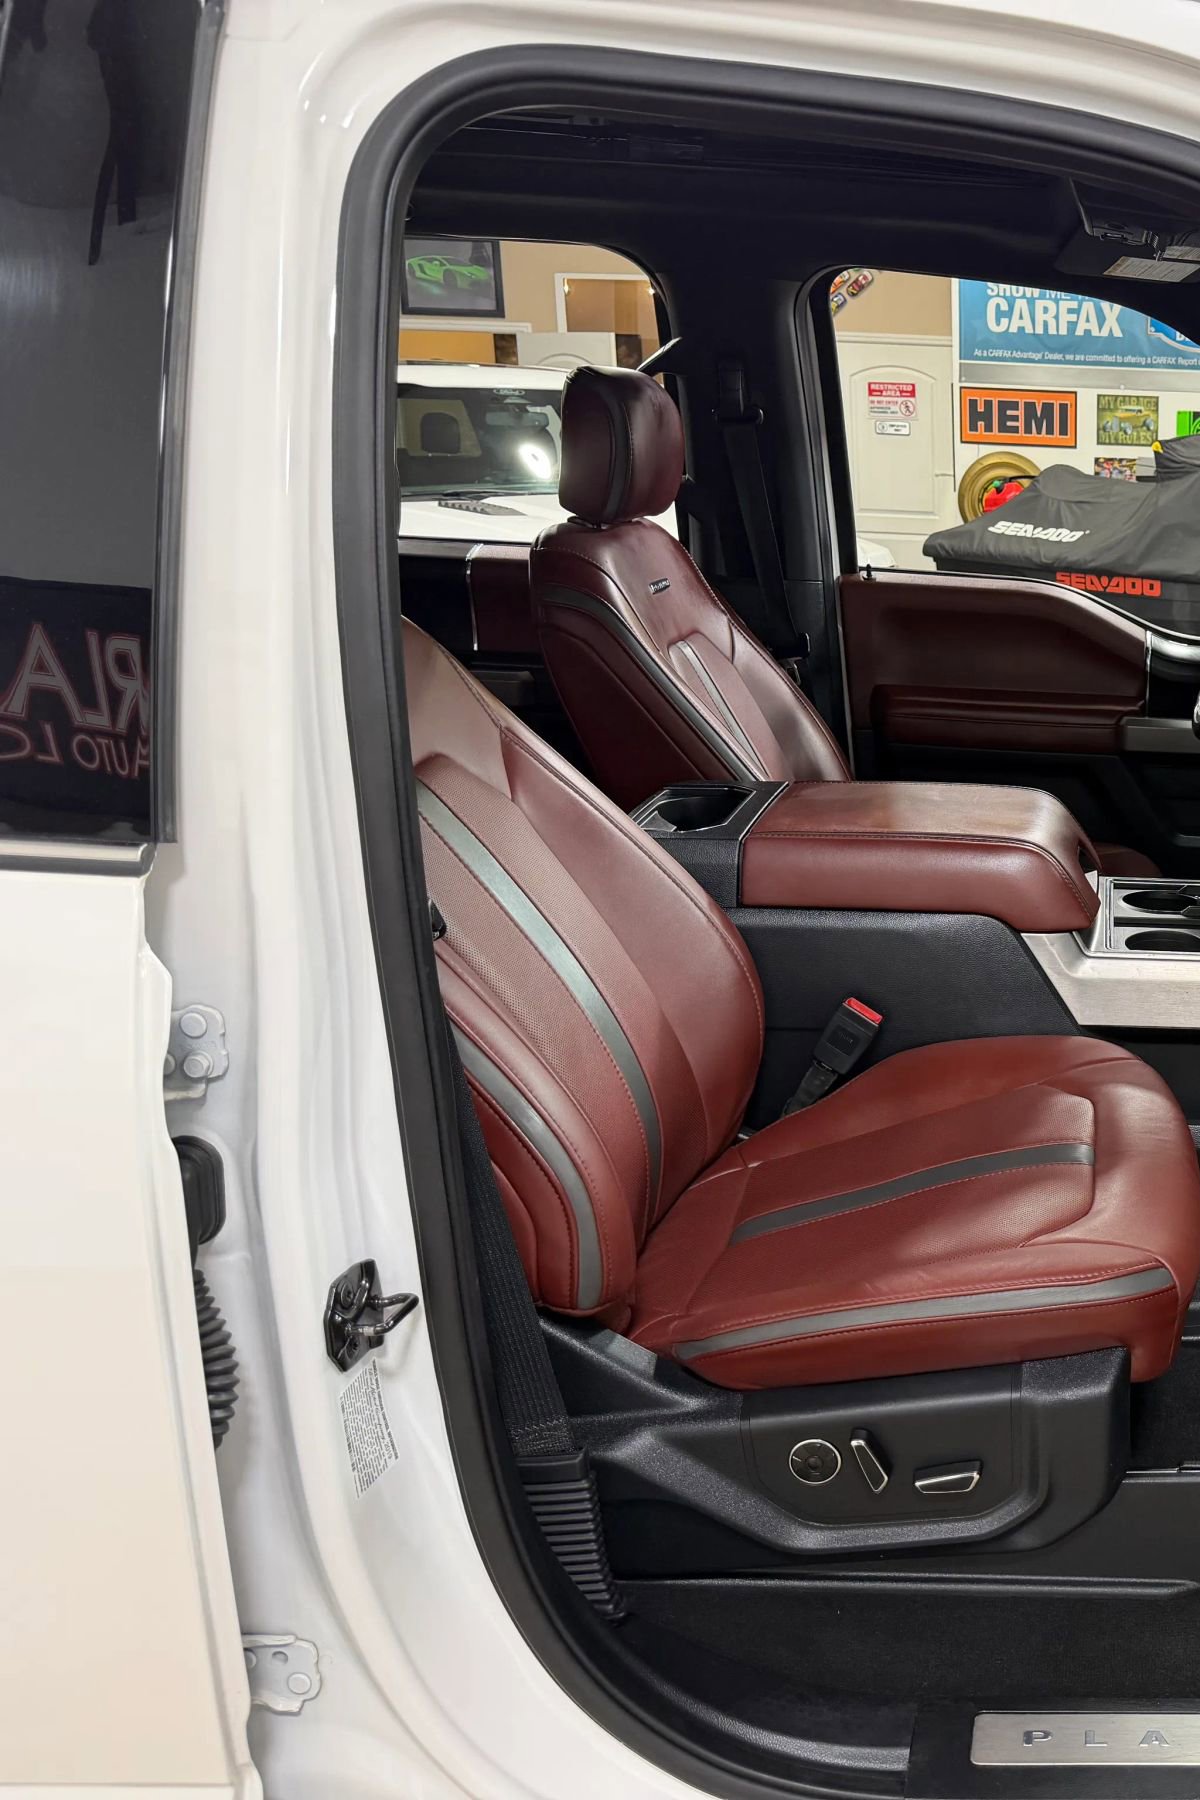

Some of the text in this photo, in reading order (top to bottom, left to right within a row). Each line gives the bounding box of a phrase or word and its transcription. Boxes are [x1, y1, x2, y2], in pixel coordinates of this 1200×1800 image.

[986, 297, 1123, 338] CARFAX
[988, 349, 1012, 359] CARFAX
[1177, 356, 1198, 367] Report
[1098, 396, 1157, 410] MY GARAGE
[967, 397, 1071, 438] HEMI
[1099, 430, 1116, 444] MY
